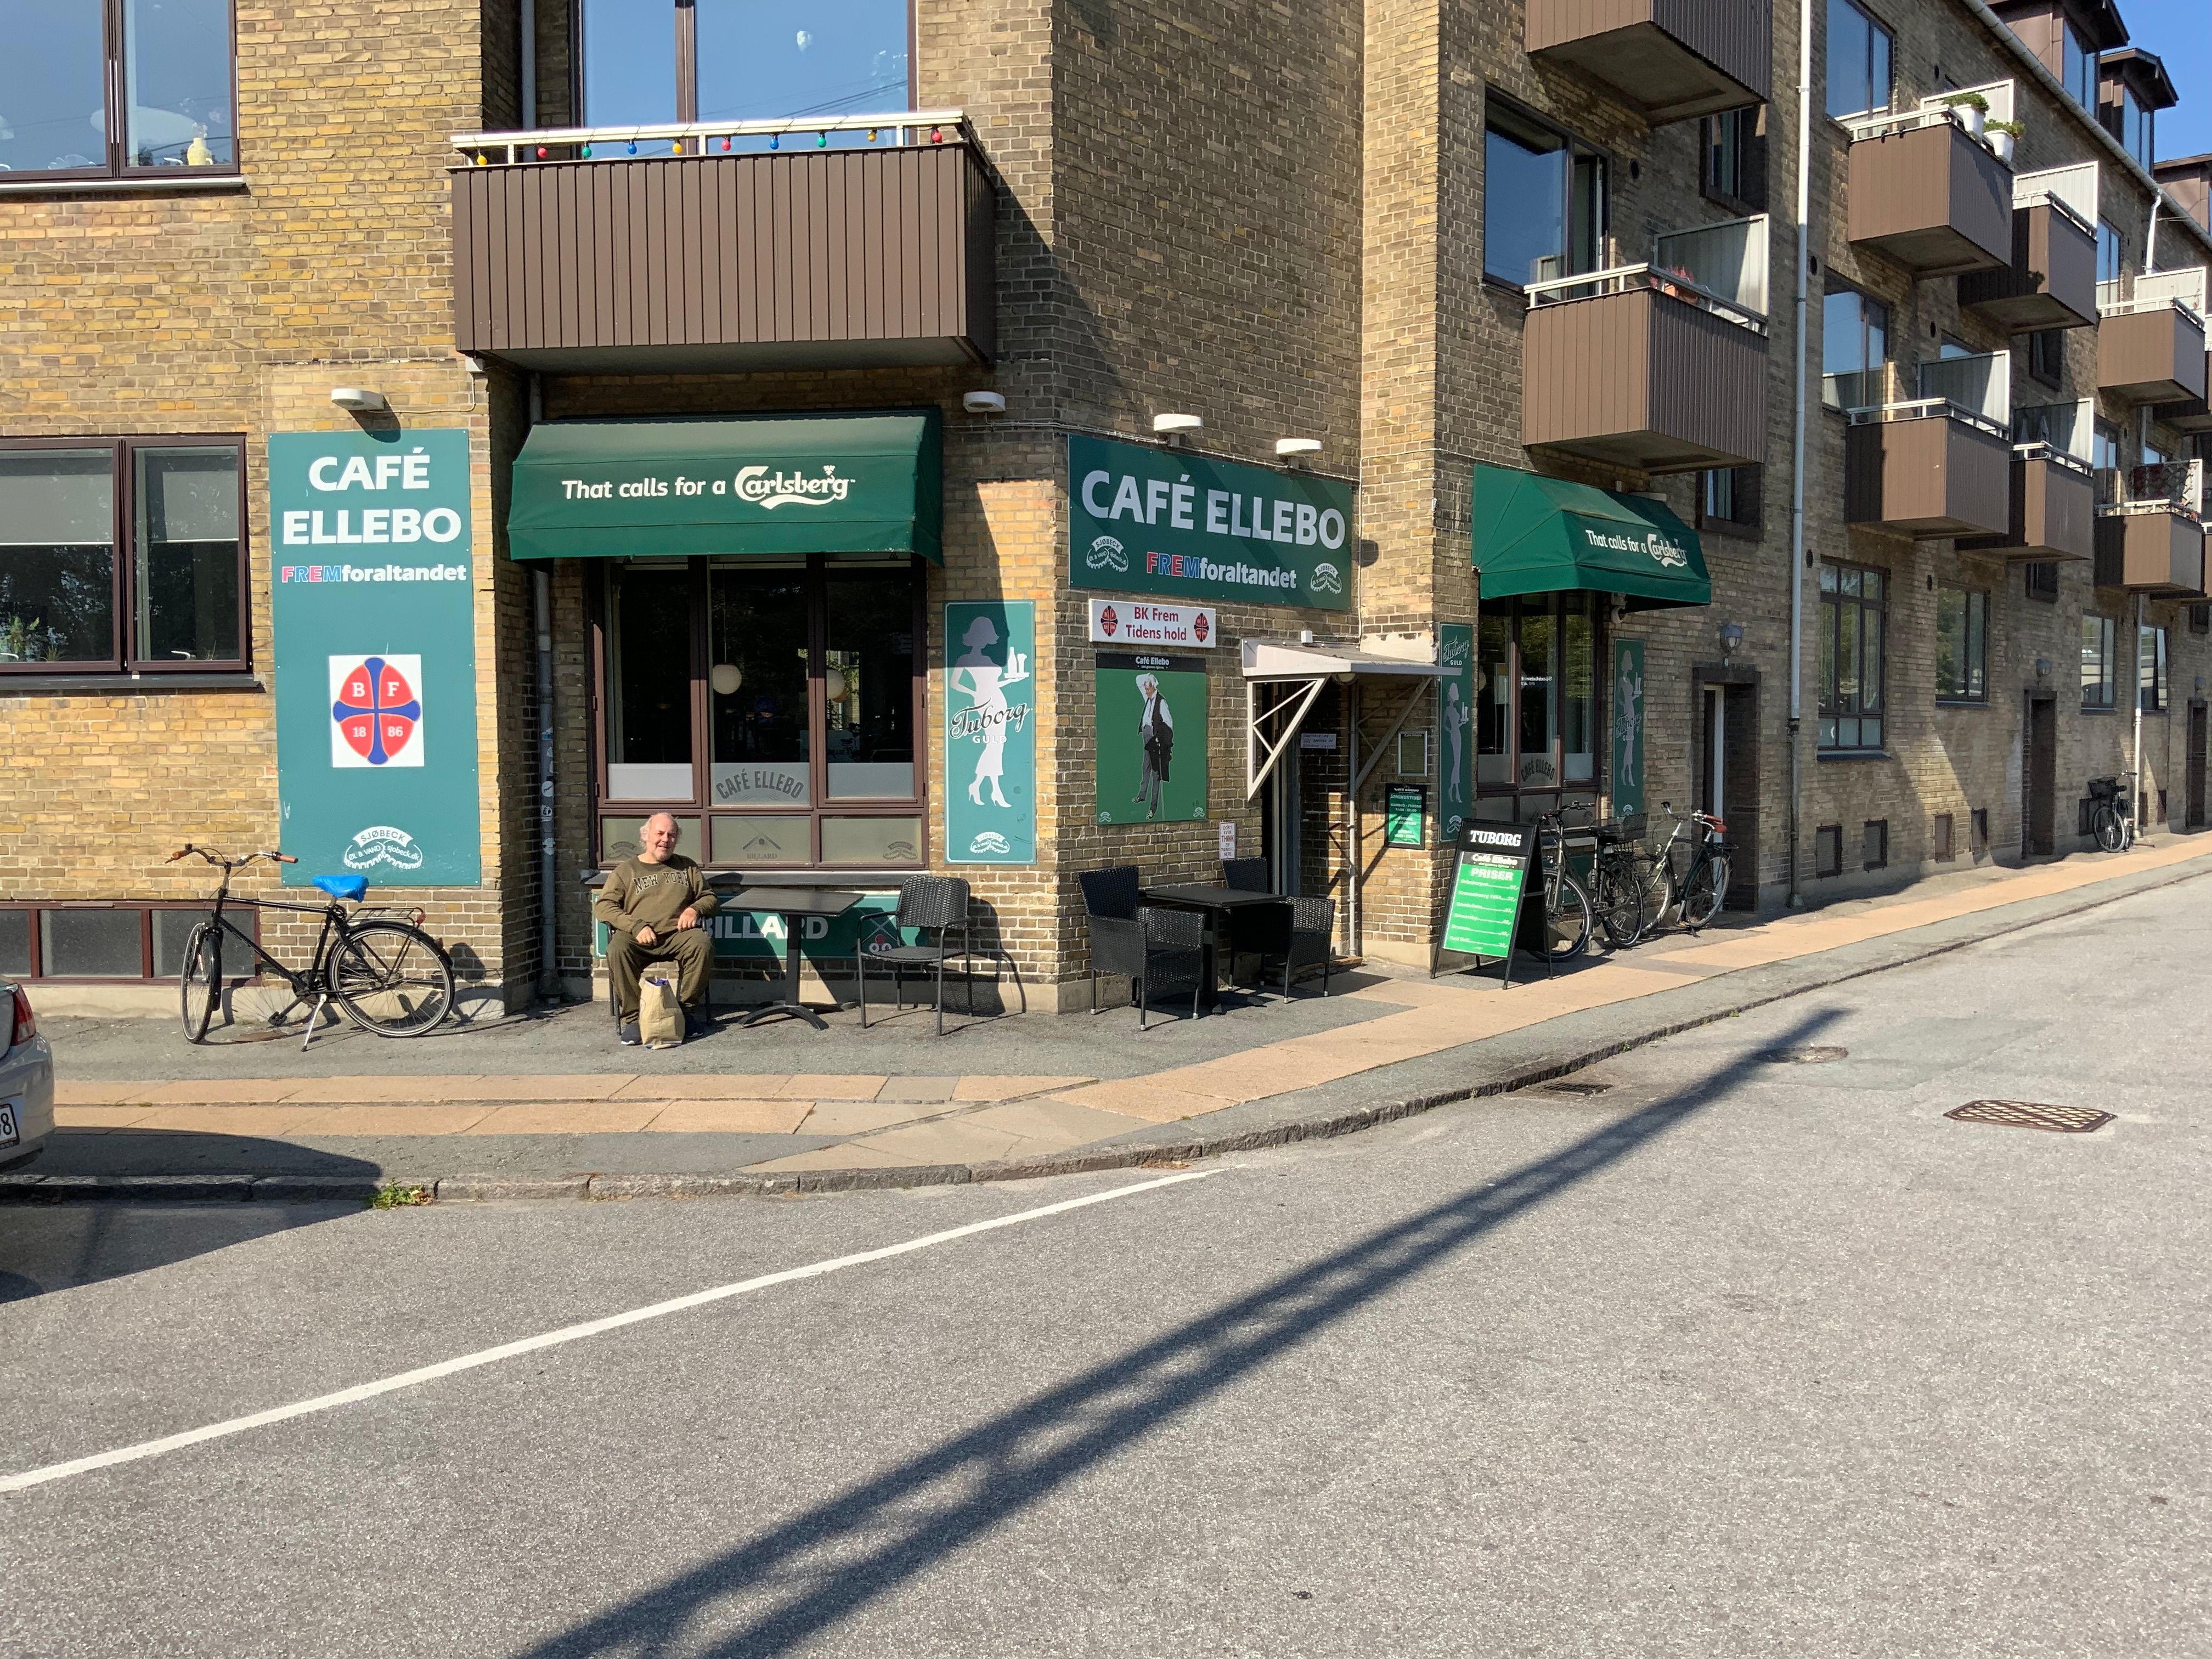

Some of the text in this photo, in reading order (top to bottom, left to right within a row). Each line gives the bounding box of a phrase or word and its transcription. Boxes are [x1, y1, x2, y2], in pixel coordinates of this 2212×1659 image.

[309, 447, 430, 491] CAFÉ
[562, 465, 849, 509] That calls for a Carlsberg
[1082, 470, 1346, 549] CAFÉ ELLEBO
[283, 508, 461, 544] ELLEBO
[1096, 538, 1120, 550] SJØBECK
[1585, 529, 1688, 567] That calls for a Carlsberg
[281, 564, 467, 583] FREMforaltandet
[1147, 551, 1297, 589] FREMforaltandet
[1135, 606, 1179, 622] BK Frem
[1126, 624, 1187, 640] Tidens hold
[1443, 635, 1470, 663] Tuborg
[1136, 656, 1170, 665] Café Ellebo
[352, 681, 400, 697] B F
[949, 697, 1029, 739] Tuborg
[352, 726, 404, 738] 18 86
[973, 735, 1007, 744] GULD
[716, 768, 804, 799] CAFÉ ELLEBO
[360, 830, 406, 842] SJØBECK
[1470, 830, 1522, 847] TUBORG
[363, 845, 381, 856] VAND
[387, 845, 420, 861] sjobeck.dk
[1472, 854, 1491, 862] Café
[1492, 856, 1518, 866] Ellebo
[1471, 867, 1514, 881] PRISER
[633, 874, 658, 895] NEW
[0, 1113, 12, 1135] 8
